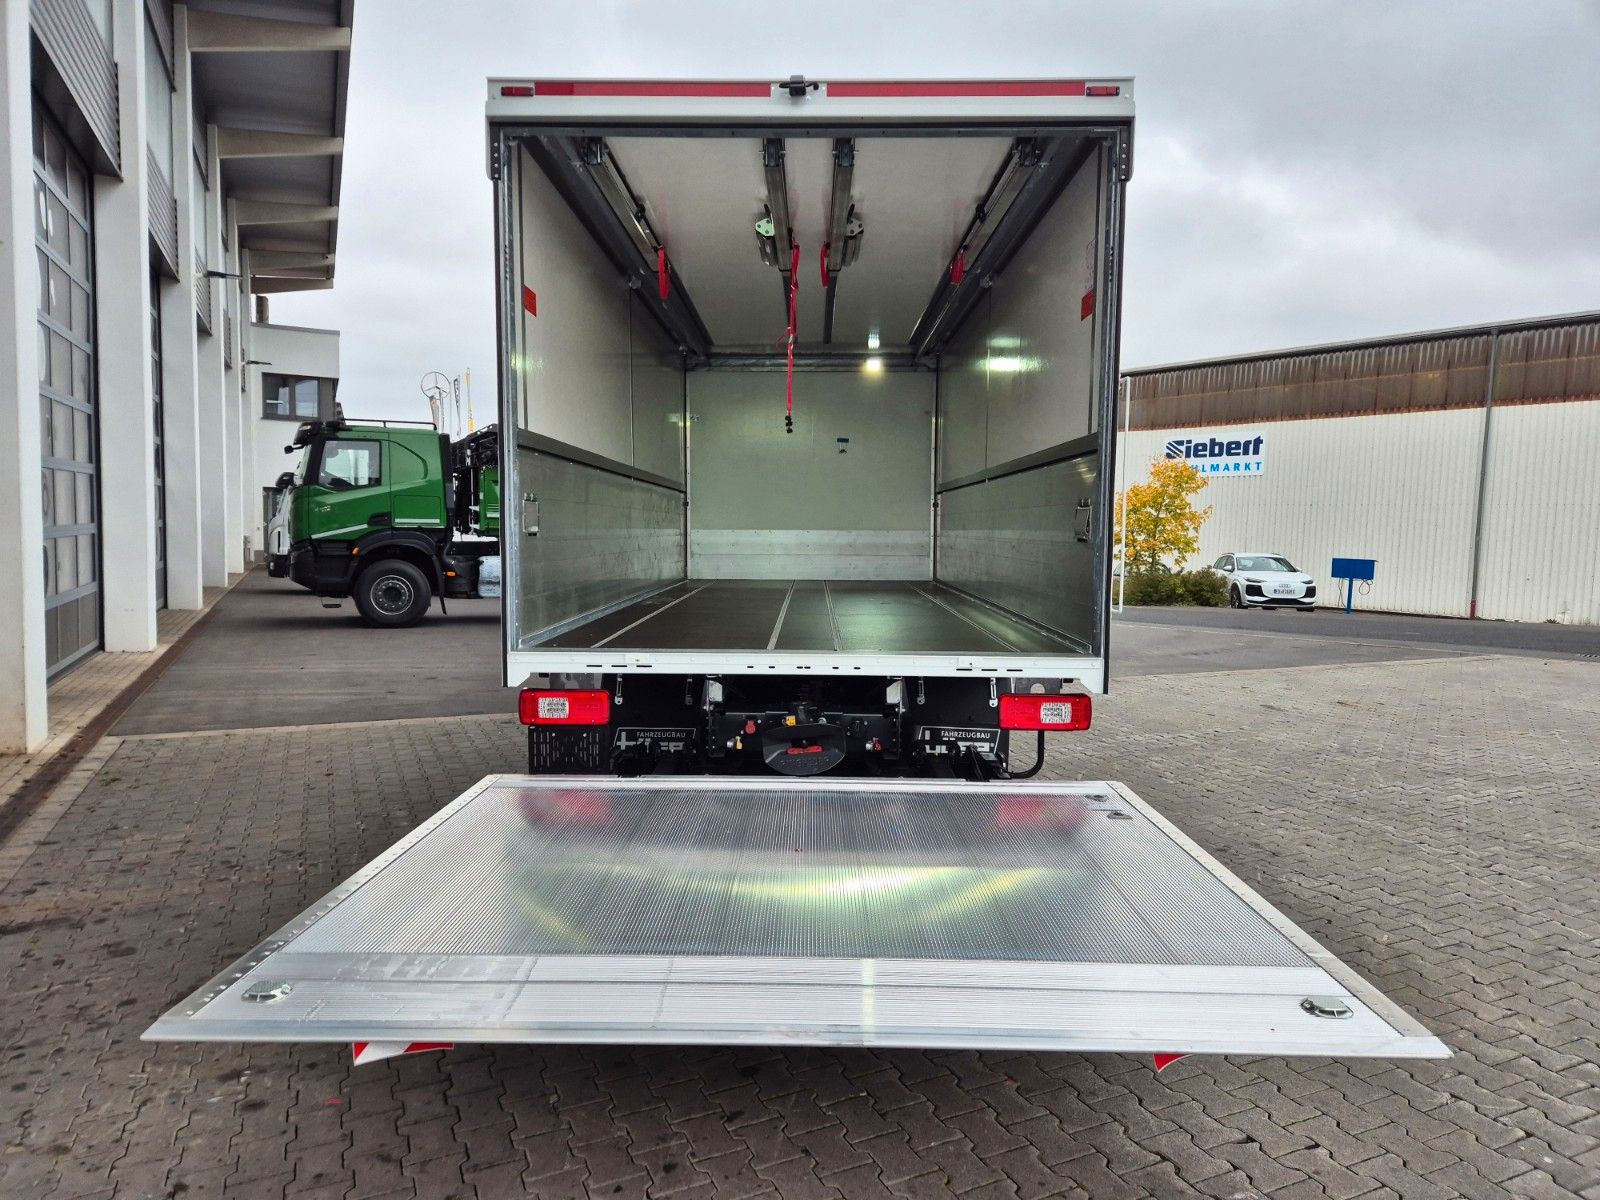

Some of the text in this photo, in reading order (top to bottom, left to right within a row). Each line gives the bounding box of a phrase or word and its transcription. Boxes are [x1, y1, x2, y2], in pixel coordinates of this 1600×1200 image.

[1165, 436, 1263, 459] Siebert
[1191, 461, 1262, 472] HLMARKT
[941, 730, 991, 739] FAHRZEUGBAU
